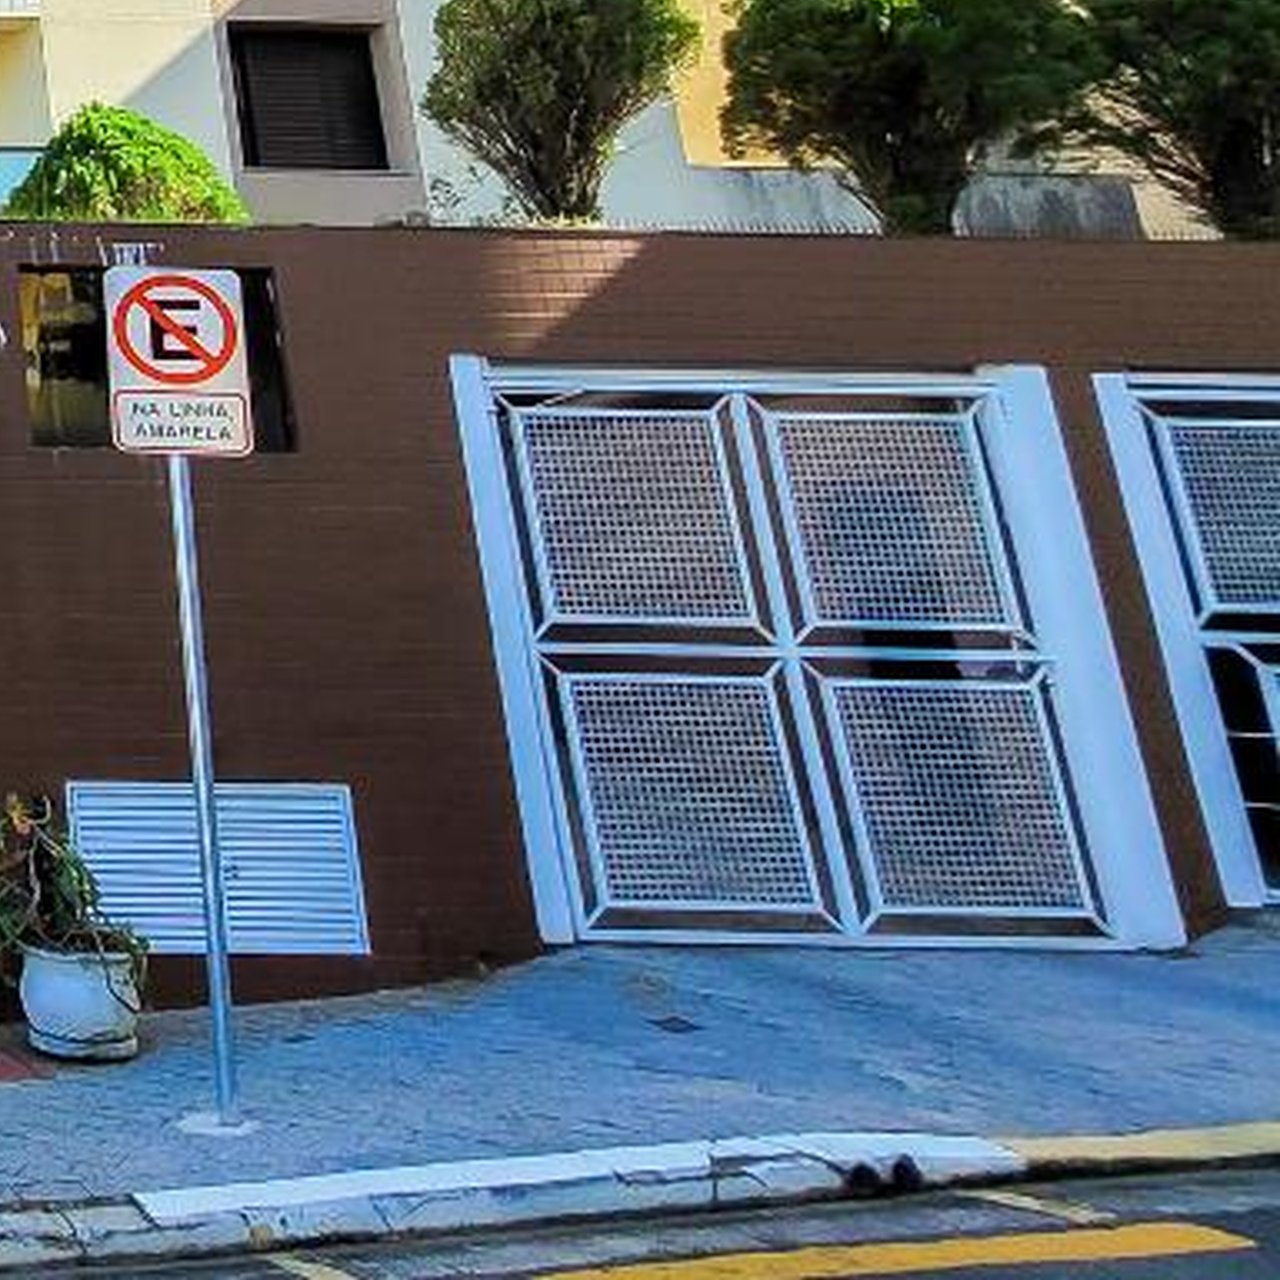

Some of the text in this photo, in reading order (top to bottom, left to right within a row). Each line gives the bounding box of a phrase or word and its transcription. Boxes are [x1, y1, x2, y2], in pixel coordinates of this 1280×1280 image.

[150, 299, 200, 360] E
[132, 402, 161, 417] NA
[136, 423, 232, 441] AMARELA
